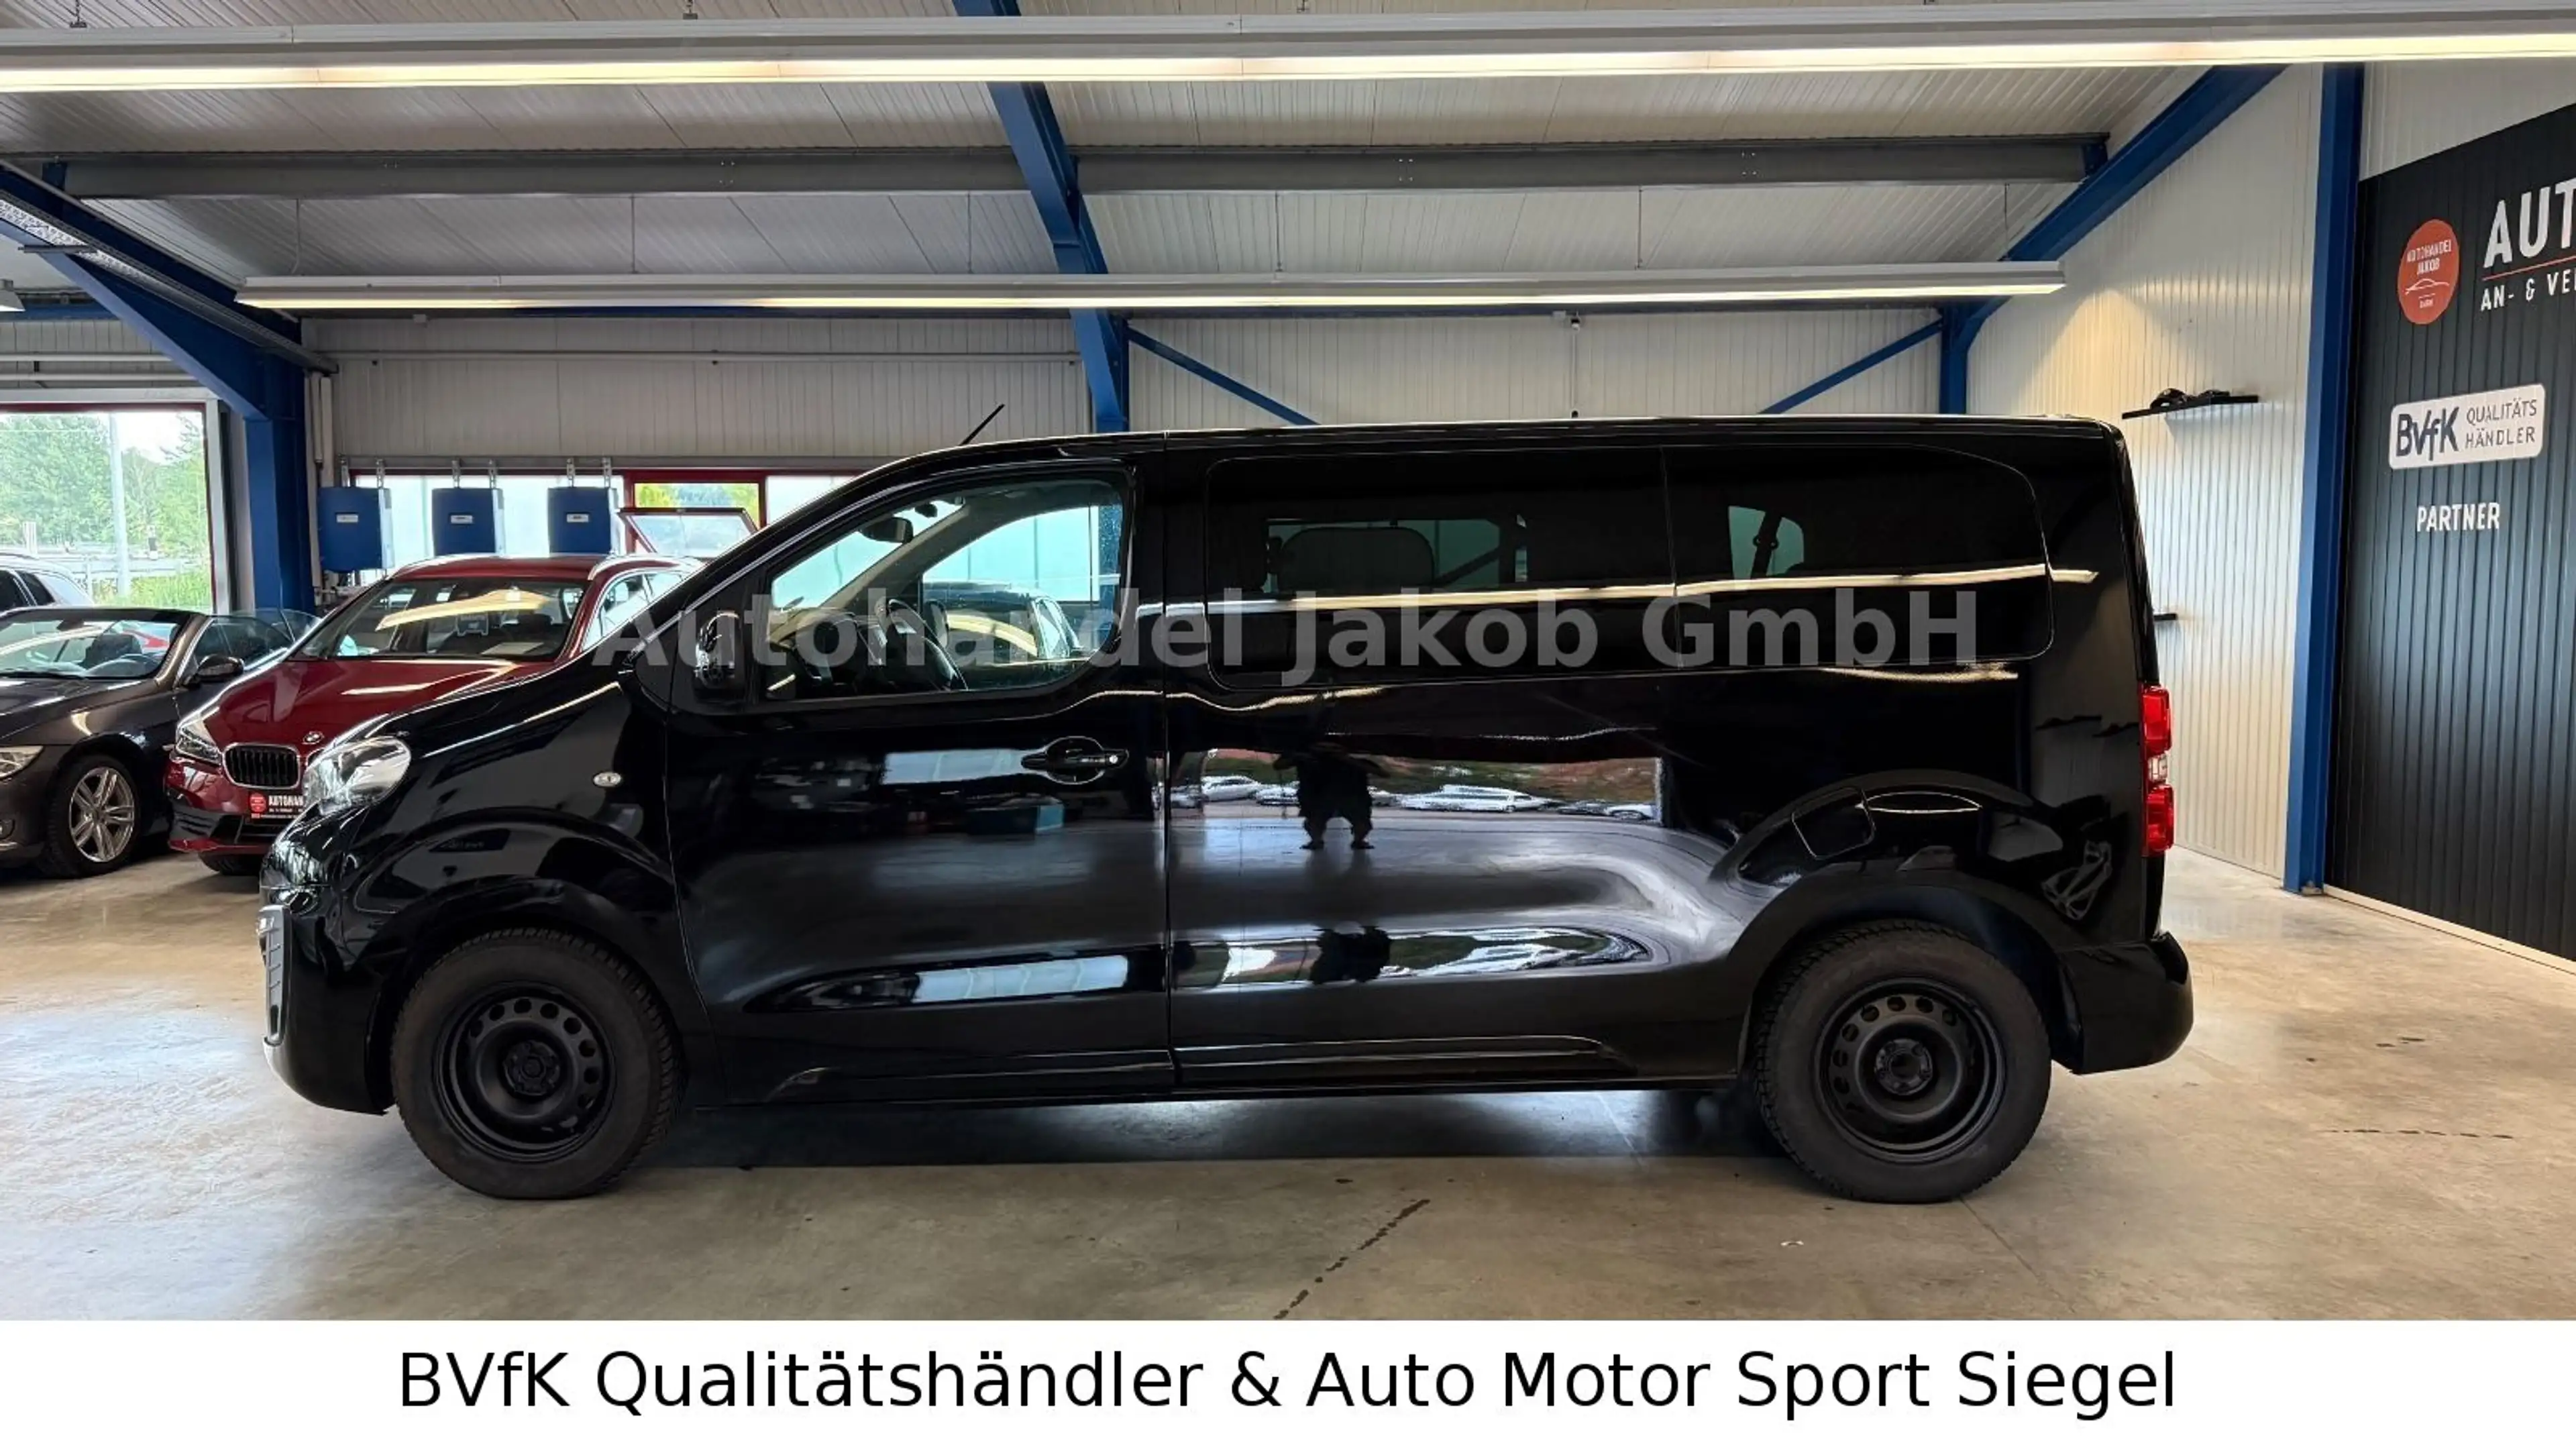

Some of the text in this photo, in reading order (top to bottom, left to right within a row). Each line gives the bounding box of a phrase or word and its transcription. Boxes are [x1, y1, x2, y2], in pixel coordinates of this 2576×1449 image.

[2481, 268, 2576, 311] AN- & VE
[2466, 397, 2537, 425] QUALITÄTS
[2396, 407, 2459, 461] BVfK
[2465, 426, 2536, 449] HÄNDLER
[2416, 502, 2500, 532] PARTNER
